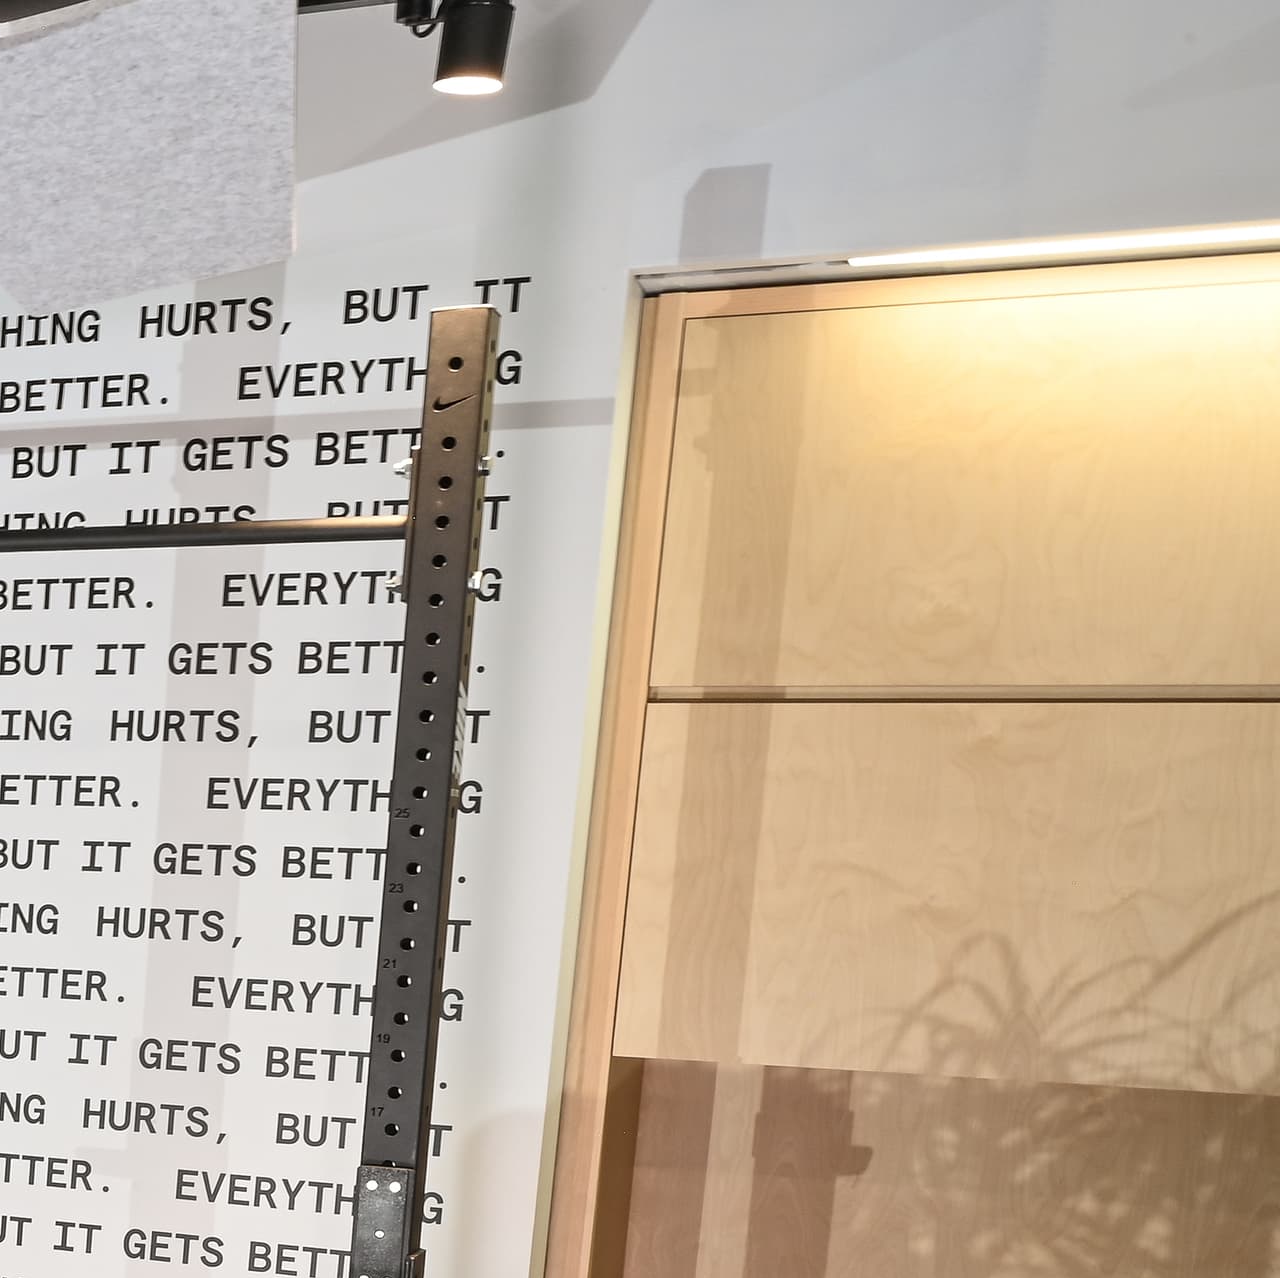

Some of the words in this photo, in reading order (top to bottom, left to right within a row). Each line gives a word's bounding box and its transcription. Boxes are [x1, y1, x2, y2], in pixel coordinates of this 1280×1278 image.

[139, 296, 291, 339] HURTS,
[343, 284, 429, 325] BUT
[473, 276, 532, 313] IT
[0, 373, 168, 414] BETTER.
[238, 349, 523, 402] EVERYTHG
[11, 443, 88, 479] BUT
[108, 440, 161, 475] IT
[183, 434, 290, 472] GETS
[314, 427, 505, 466] BETT.
[222, 567, 504, 608] EVERYTG
[0, 644, 73, 676] BUT
[95, 643, 146, 675] IT
[168, 642, 273, 675] GETS
[297, 640, 485, 676] BETT.
[110, 709, 258, 748] HURTS,
[308, 710, 392, 744] BUT
[206, 777, 484, 814] EVERYTHG
[393, 807, 411, 820] 25
[81, 840, 132, 873] IT
[153, 842, 257, 877] GETS
[281, 846, 467, 884] BETT.
[388, 883, 405, 895] 23
[96, 906, 242, 949] HURTS,
[292, 913, 374, 948] BUT
[382, 958, 398, 970] 21
[191, 975, 465, 1022] EVERYTHG
[376, 1032, 391, 1044] 19
[68, 1033, 118, 1066] IT
[139, 1038, 241, 1075] GETS
[265, 1046, 448, 1090] BETT.
[82, 1098, 226, 1145] HURTS,
[276, 1113, 357, 1149] BUT
[370, 1106, 385, 1118] 17
[175, 1169, 445, 1225] EVERYTHG
[53, 1220, 102, 1254] IT
[123, 1228, 224, 1268] GETS
